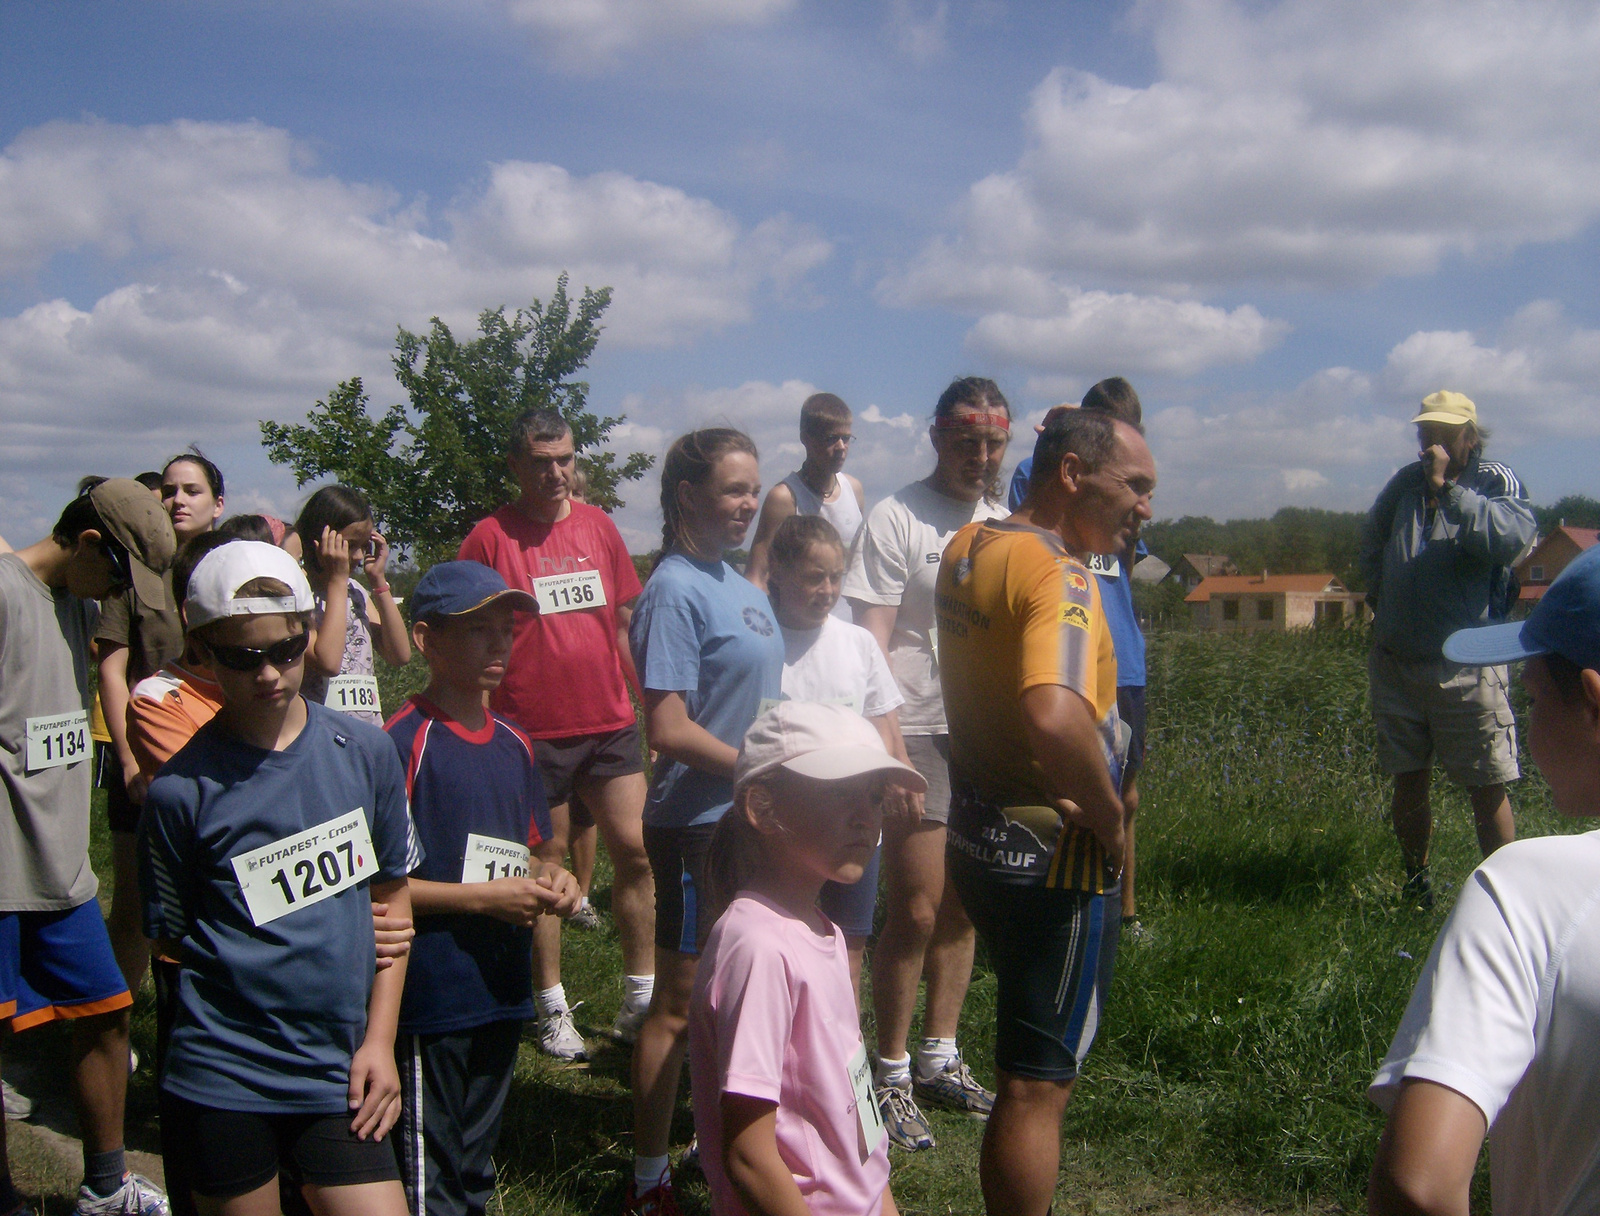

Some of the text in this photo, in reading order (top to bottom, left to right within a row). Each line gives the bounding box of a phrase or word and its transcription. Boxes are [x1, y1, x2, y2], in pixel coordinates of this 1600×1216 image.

[540, 556, 578, 573] run
[544, 577, 574, 587] FUTAPEST
[549, 584, 594, 607] 1136
[338, 687, 374, 706] 1183
[39, 719, 71, 731] FUTAPEST
[42, 728, 85, 760] 1134
[259, 835, 319, 868] FUTAPEST
[328, 820, 359, 839] Cross
[483, 845, 521, 859] FUTAPEST
[270, 840, 356, 904] 1207
